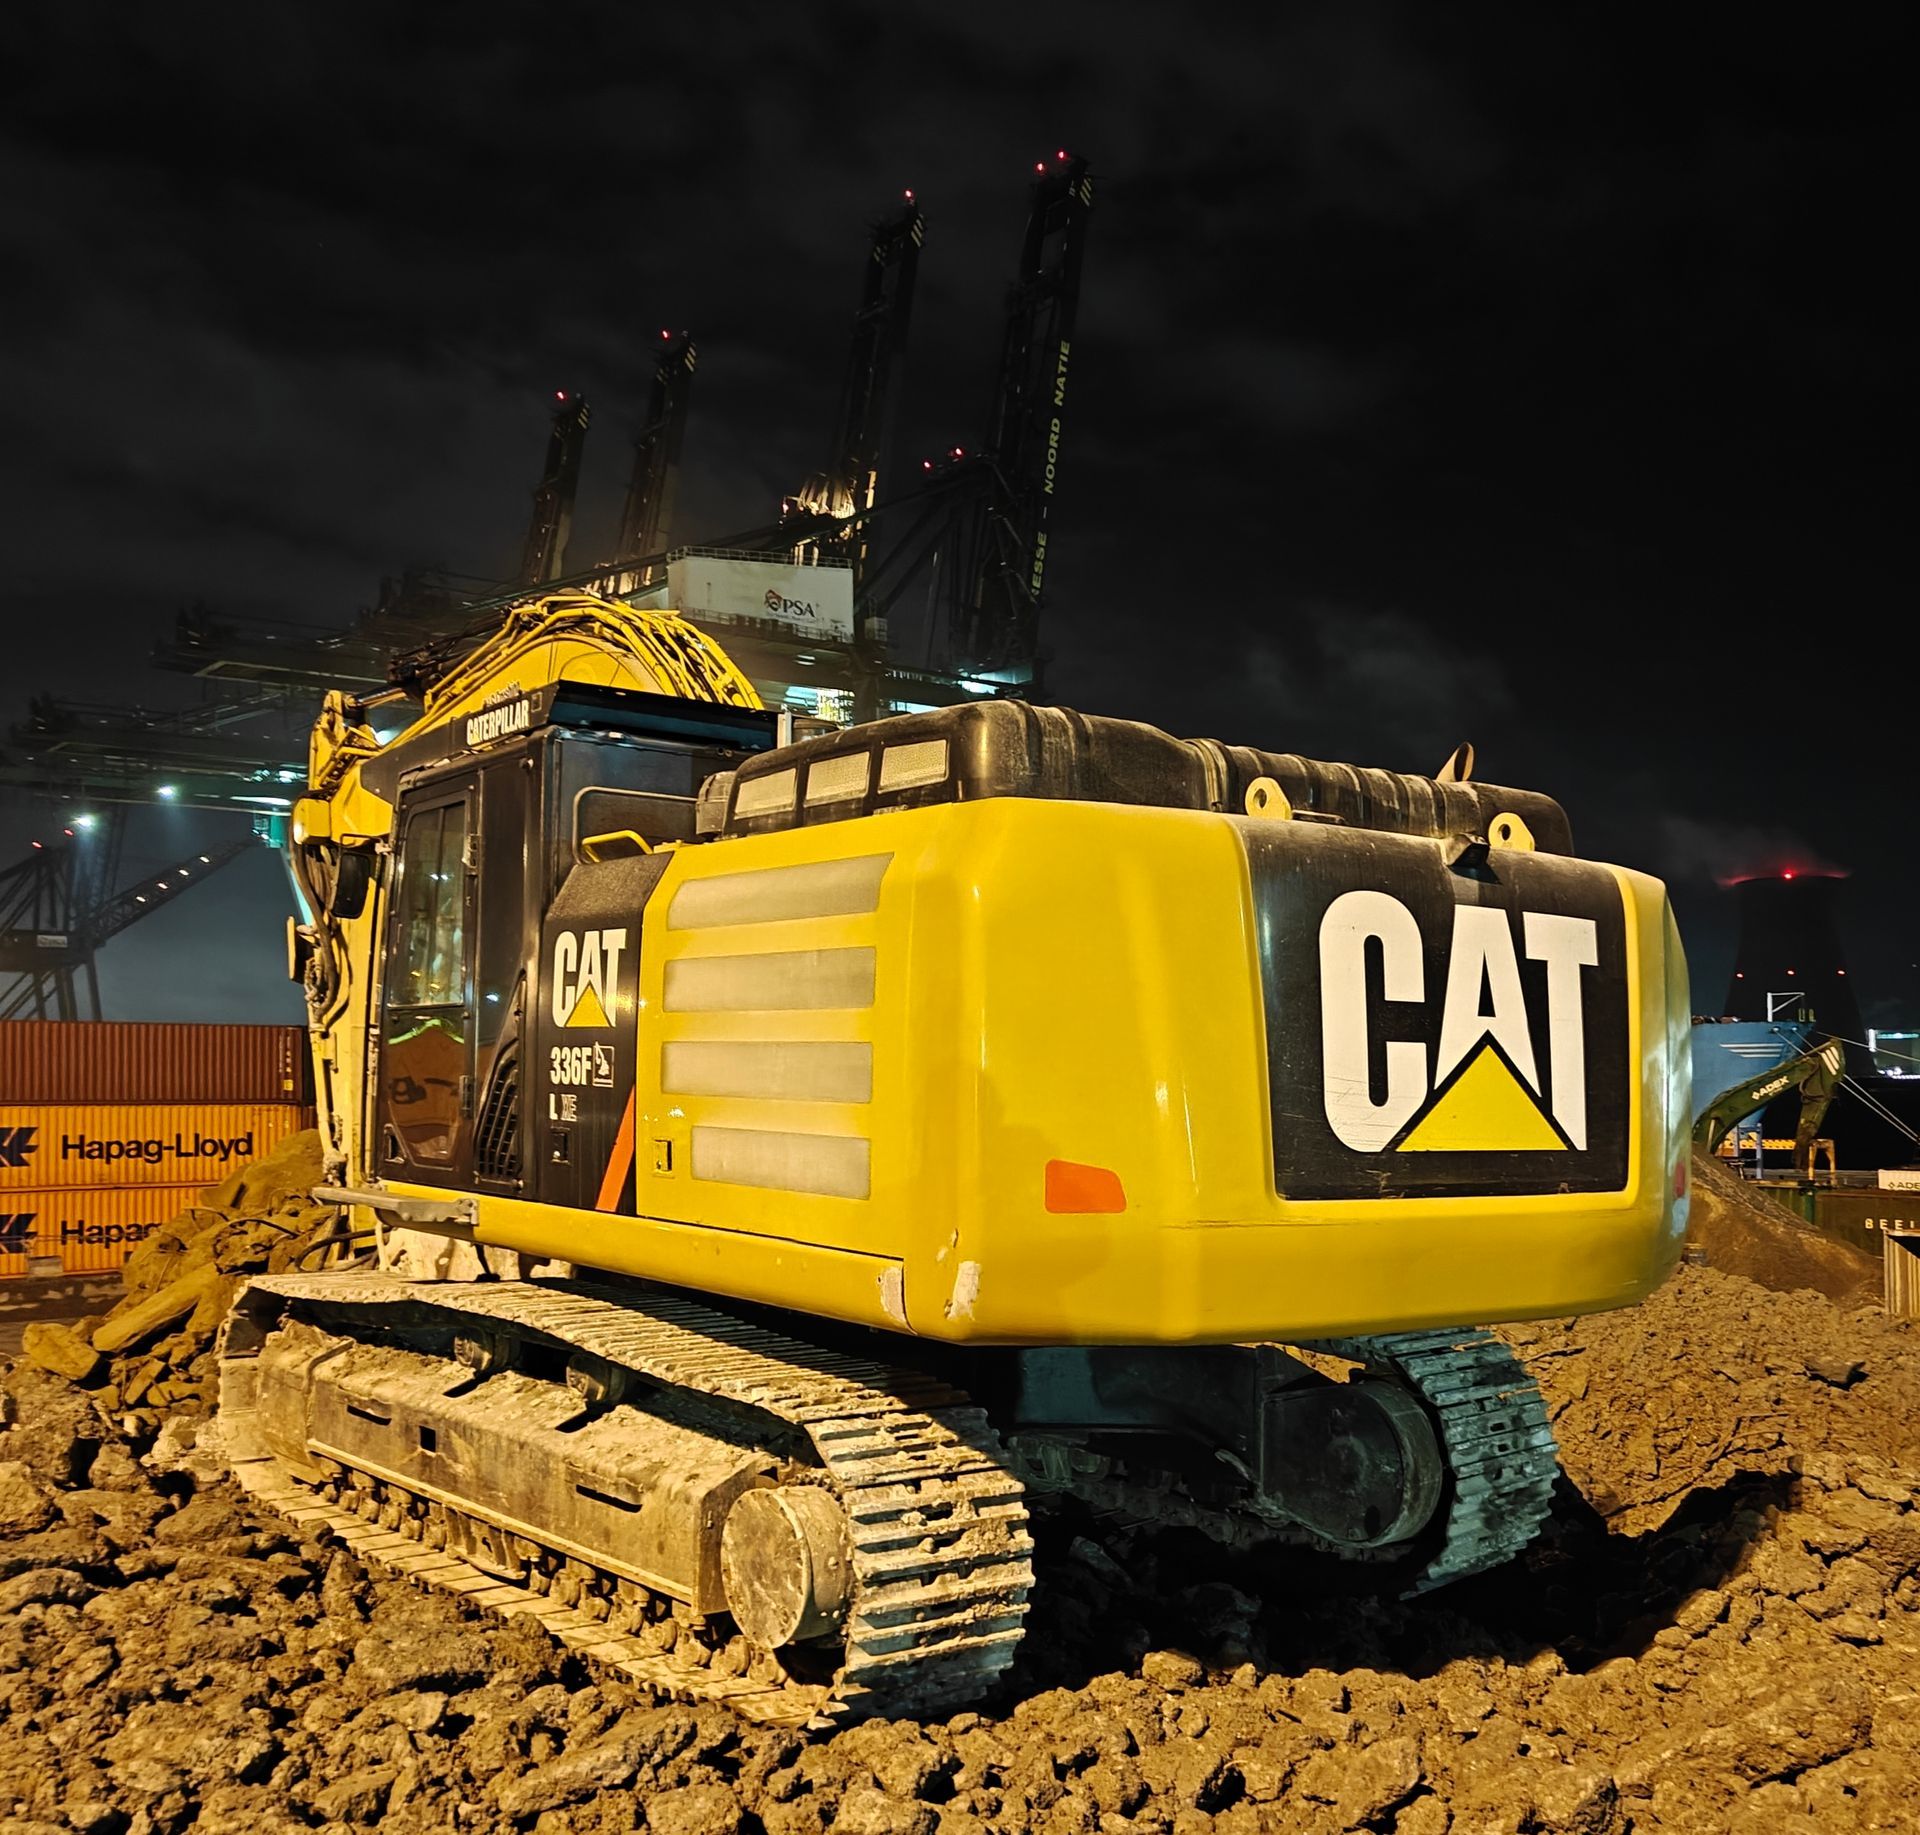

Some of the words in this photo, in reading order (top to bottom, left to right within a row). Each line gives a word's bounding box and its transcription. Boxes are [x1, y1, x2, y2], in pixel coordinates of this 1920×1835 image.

[1044, 416, 1061, 494] NOORD
[1054, 339, 1070, 406] NATIE
[783, 598, 815, 618] PSA
[466, 699, 530, 746] CATERPILLAR
[551, 928, 628, 1028] CAT
[1318, 890, 1599, 1153] CAT
[549, 1046, 592, 1086] 336F
[1759, 1075, 1790, 1097] ADEX
[61, 1131, 254, 1165] Hapag-Lloyd
